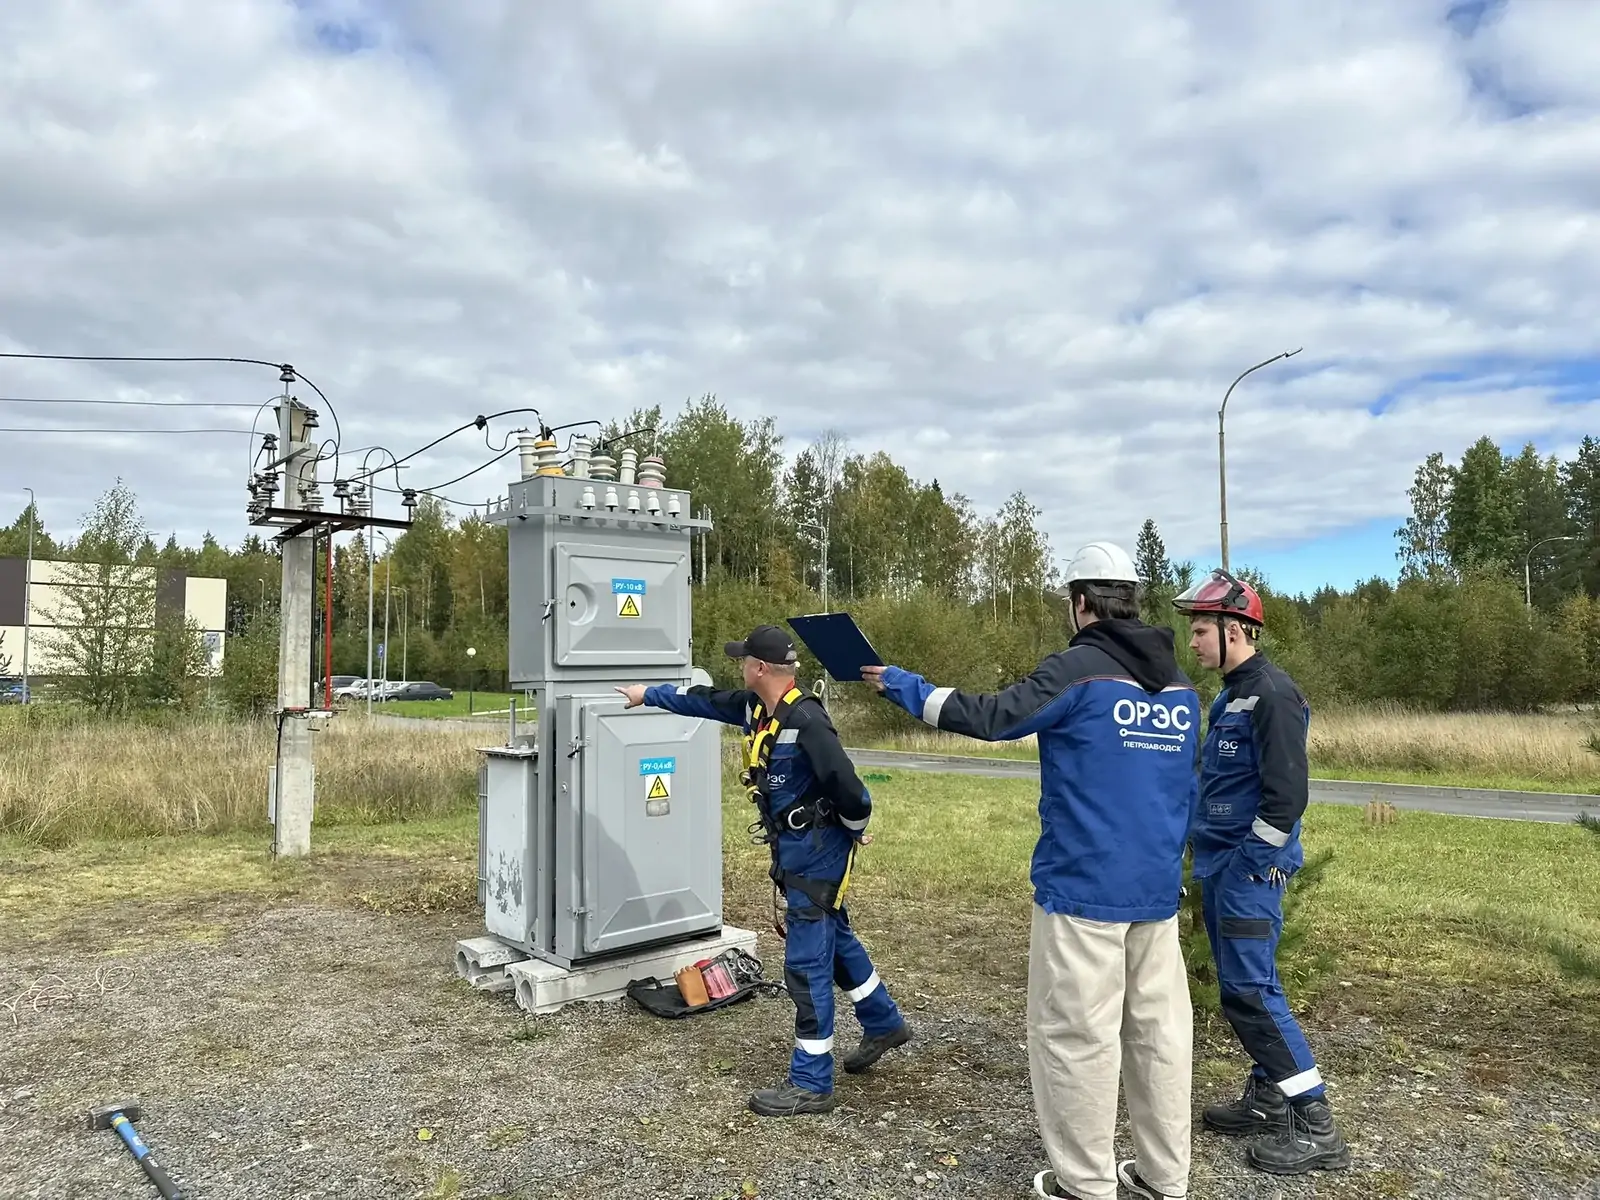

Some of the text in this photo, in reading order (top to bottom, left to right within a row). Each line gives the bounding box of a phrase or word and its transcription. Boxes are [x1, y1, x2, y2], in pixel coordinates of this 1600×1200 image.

[615, 582, 634, 591] РУ-10
[1113, 699, 1191, 731] ОРЭС
[1123, 740, 1182, 752] ПЕТРОЗАВОДСК
[642, 762, 664, 771] РУ-0,4
